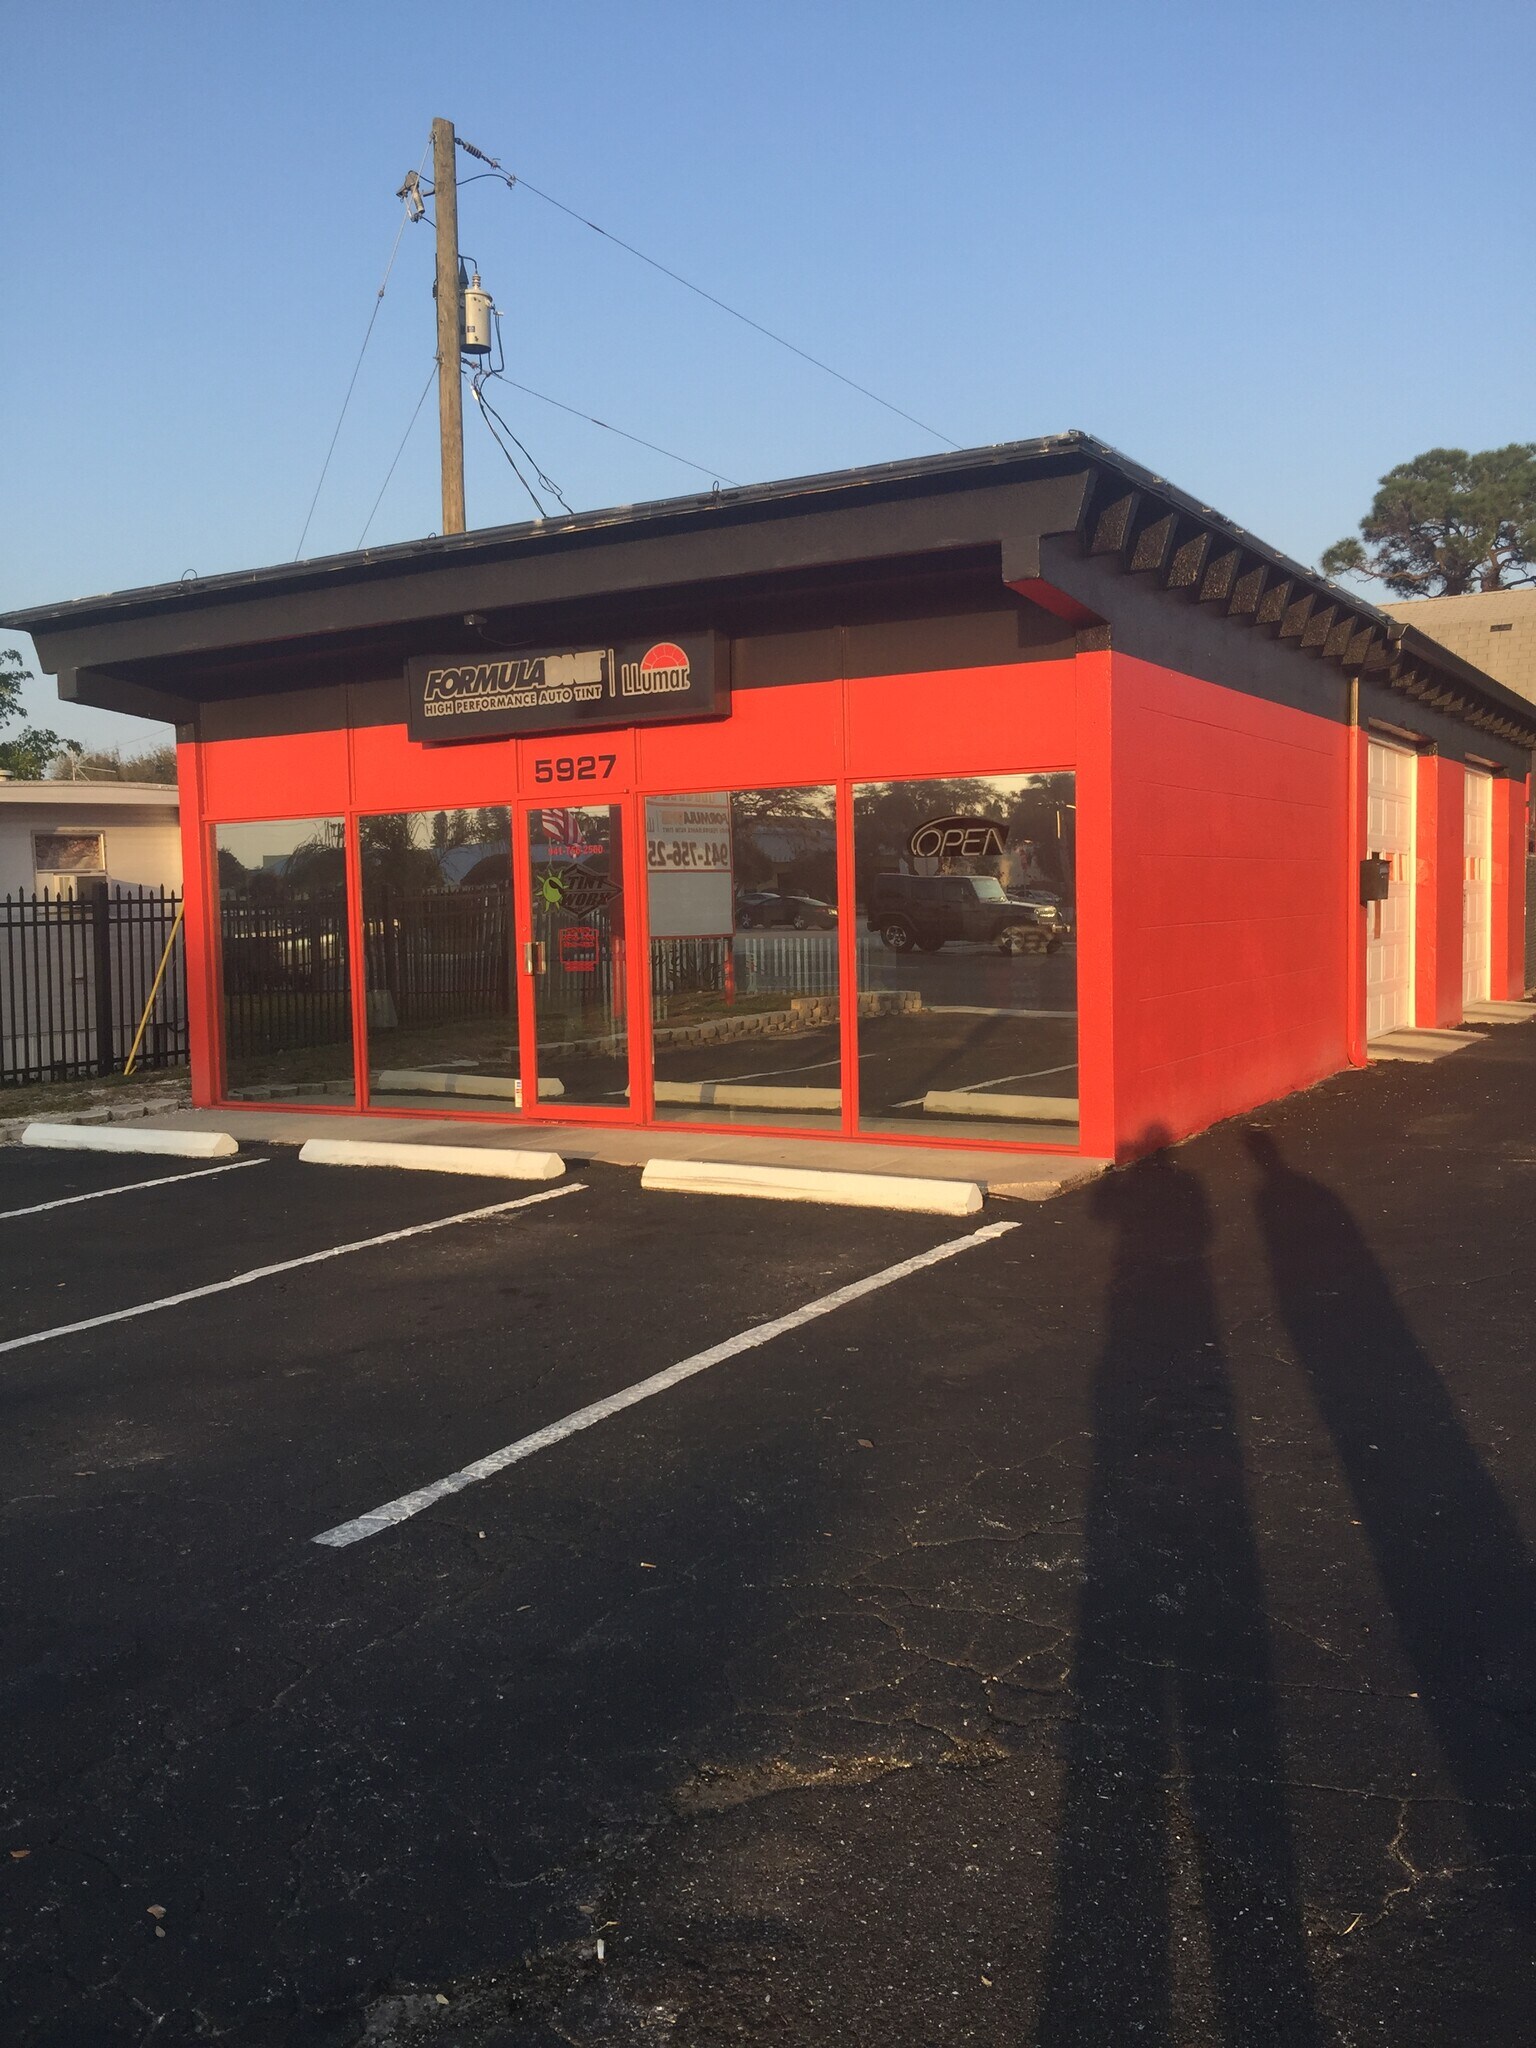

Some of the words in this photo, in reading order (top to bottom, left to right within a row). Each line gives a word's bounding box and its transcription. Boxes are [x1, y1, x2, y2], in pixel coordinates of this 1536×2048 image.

[425, 700, 454, 717] HIGH
[455, 691, 537, 714] PERFORMANCE
[539, 687, 573, 705] AUTO
[574, 684, 602, 701] TINT
[535, 754, 616, 783] 5927
[915, 828, 1004, 857] OPEN
